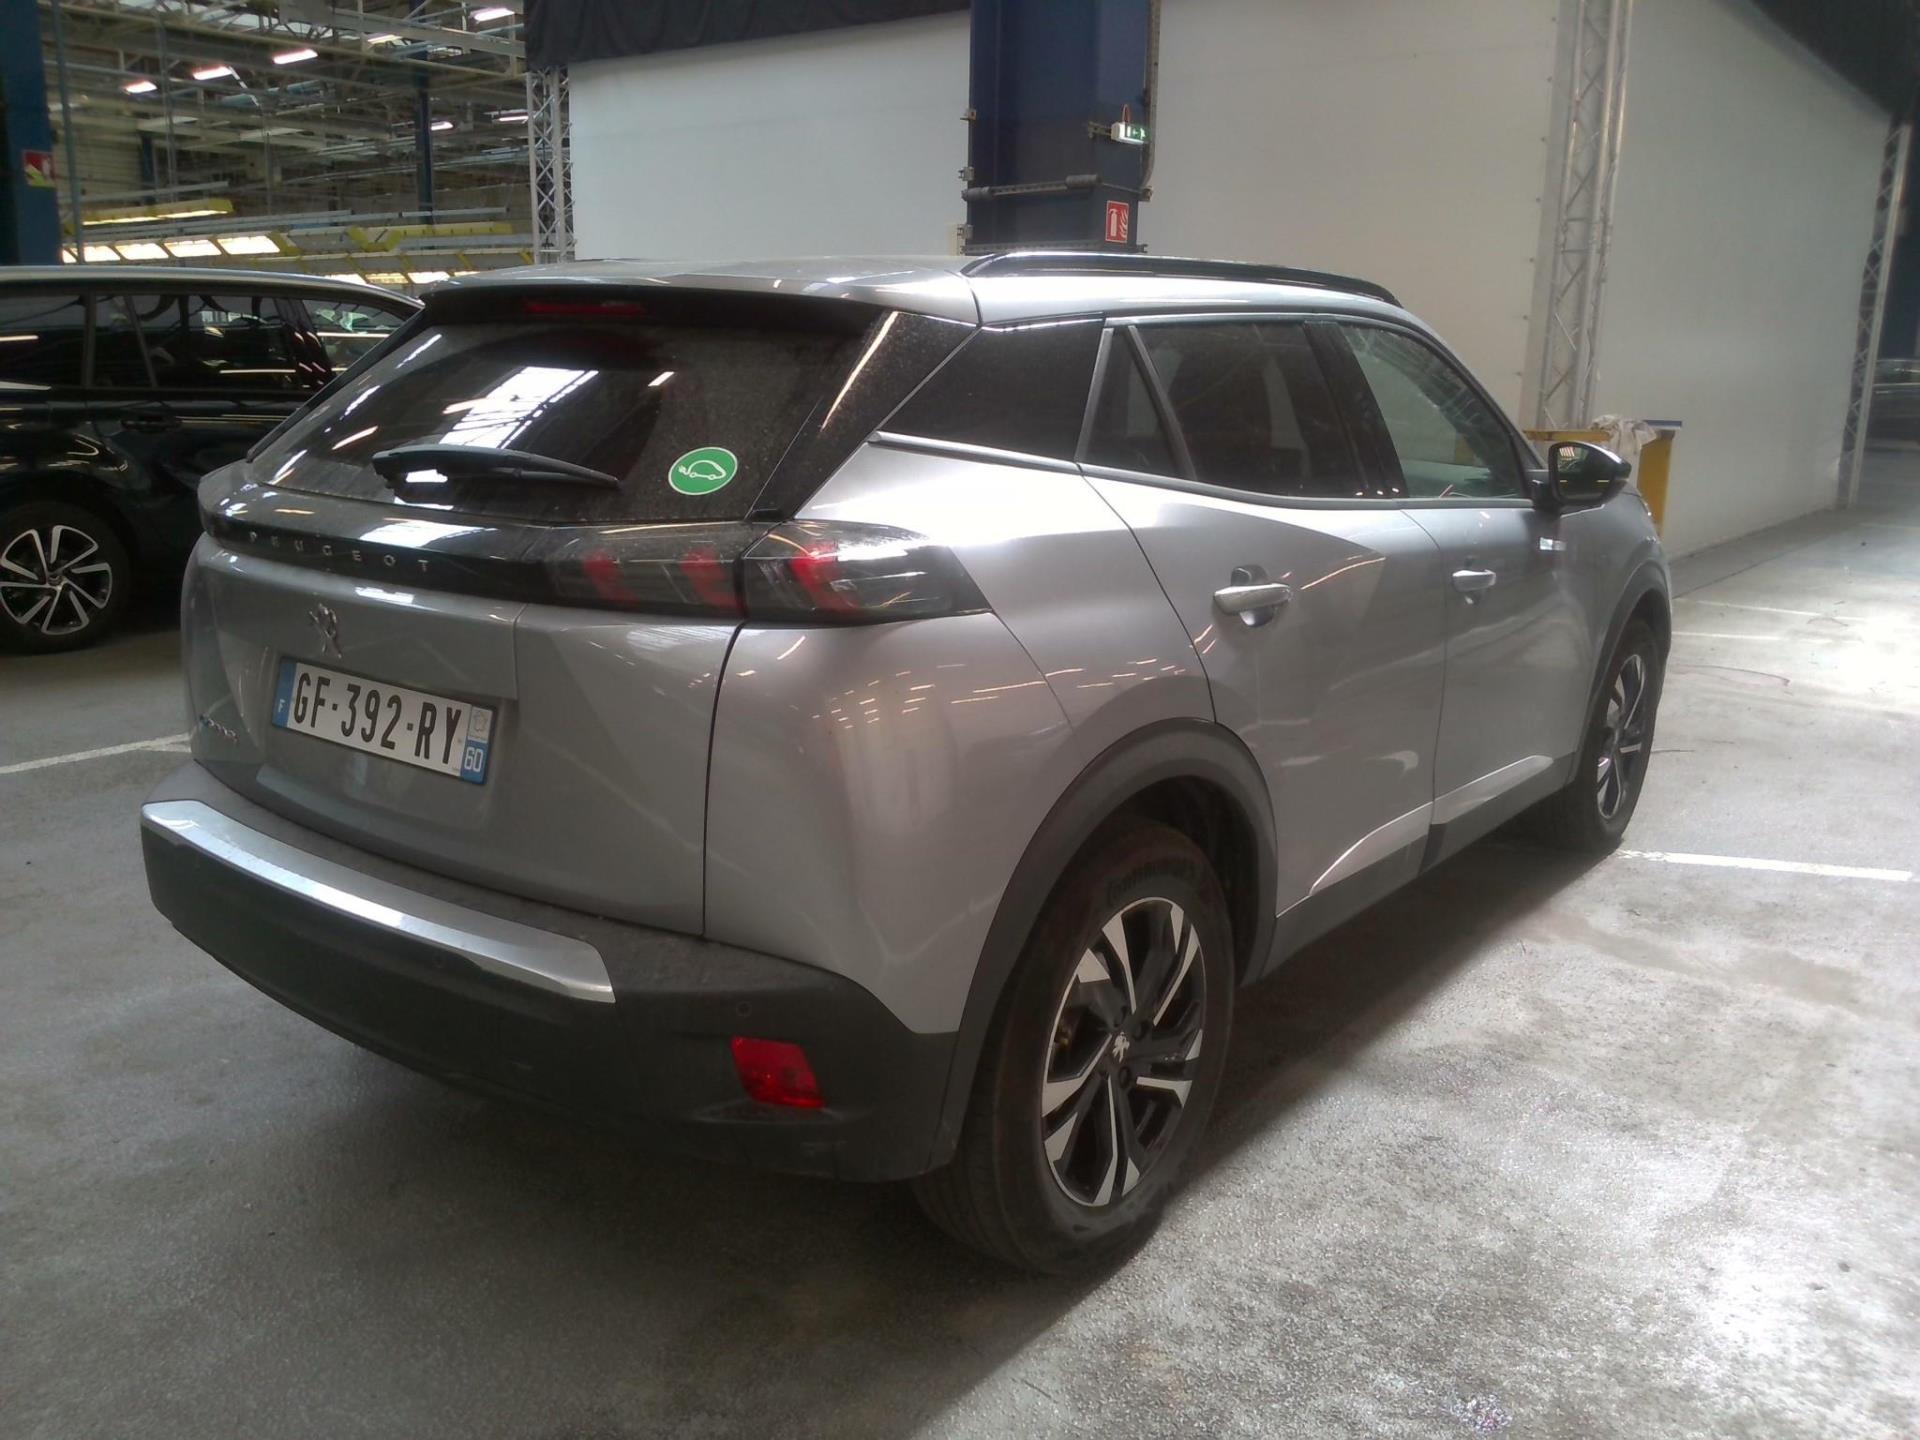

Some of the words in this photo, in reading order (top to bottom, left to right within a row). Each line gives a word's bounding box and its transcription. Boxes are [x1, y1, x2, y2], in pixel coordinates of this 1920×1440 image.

[249, 531, 429, 573] PEUGEOT
[293, 672, 462, 765] GF-392-RY
[464, 746, 484, 773] 60
